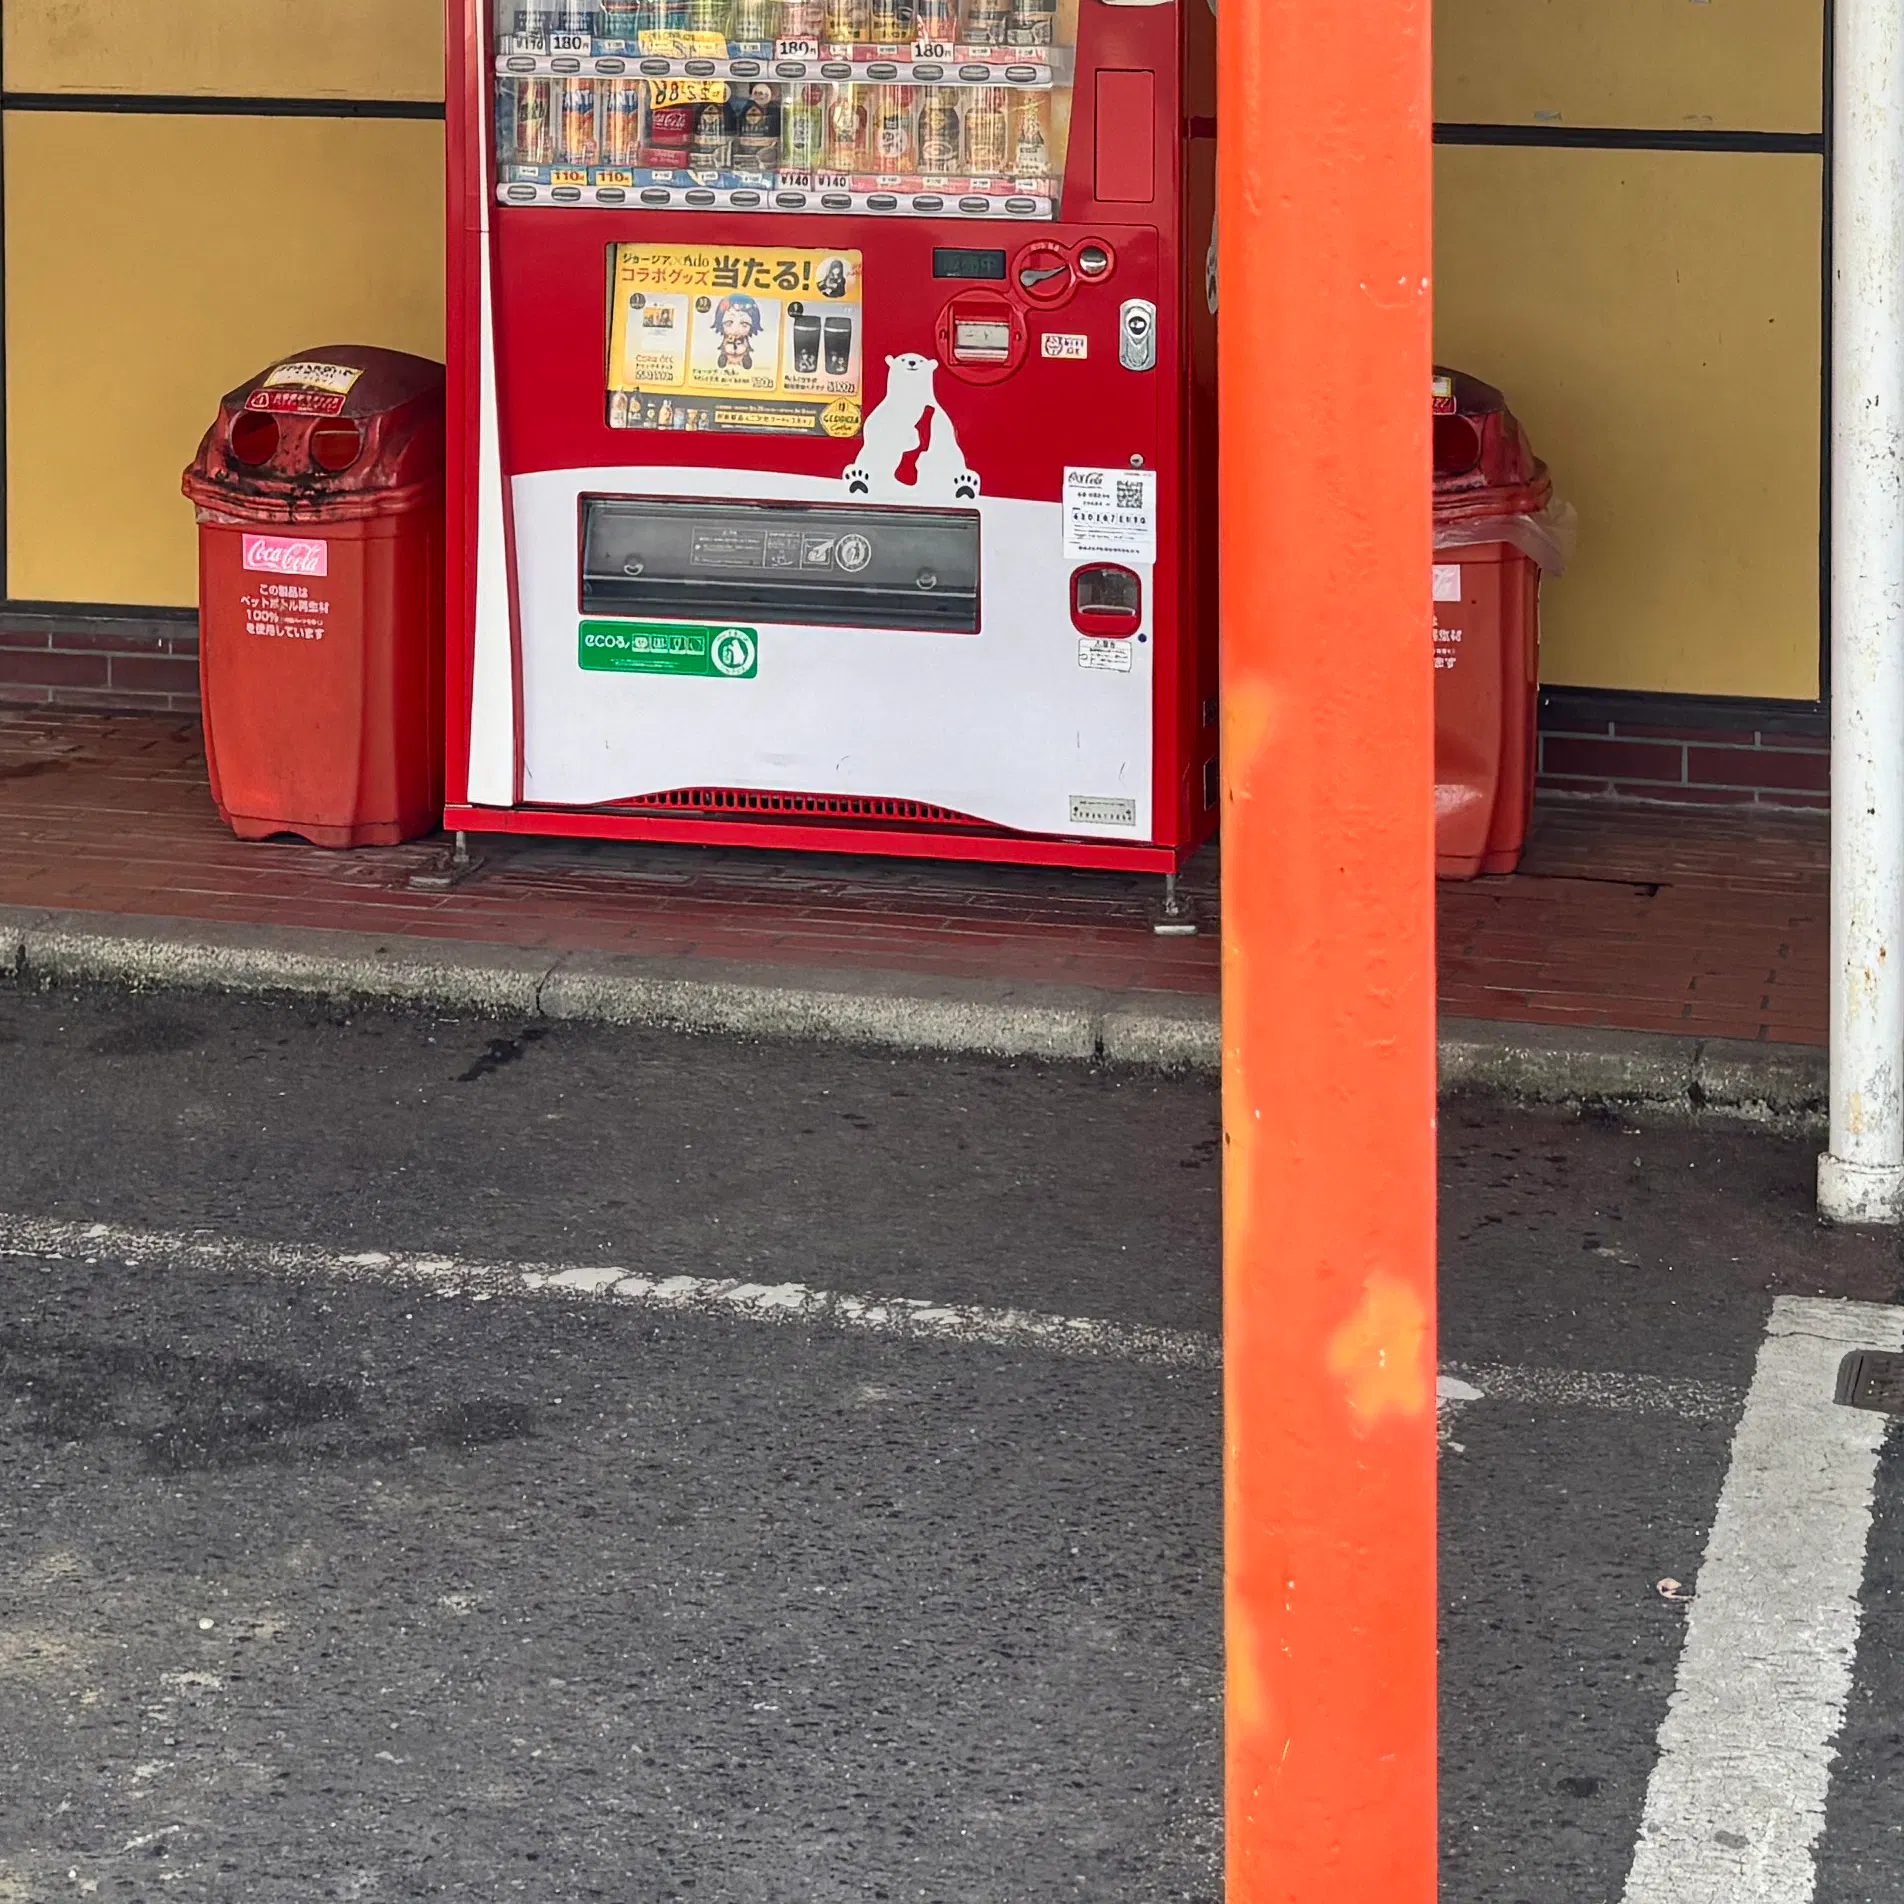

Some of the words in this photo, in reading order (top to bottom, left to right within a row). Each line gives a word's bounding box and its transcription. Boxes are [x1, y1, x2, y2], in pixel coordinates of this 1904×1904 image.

[621, 267, 712, 286] コラボグッズ
[711, 255, 812, 291] 当たる!
[249, 539, 322, 571] Coca-Cola
[246, 609, 279, 623] 100%
[246, 622, 325, 640] を使用しています
